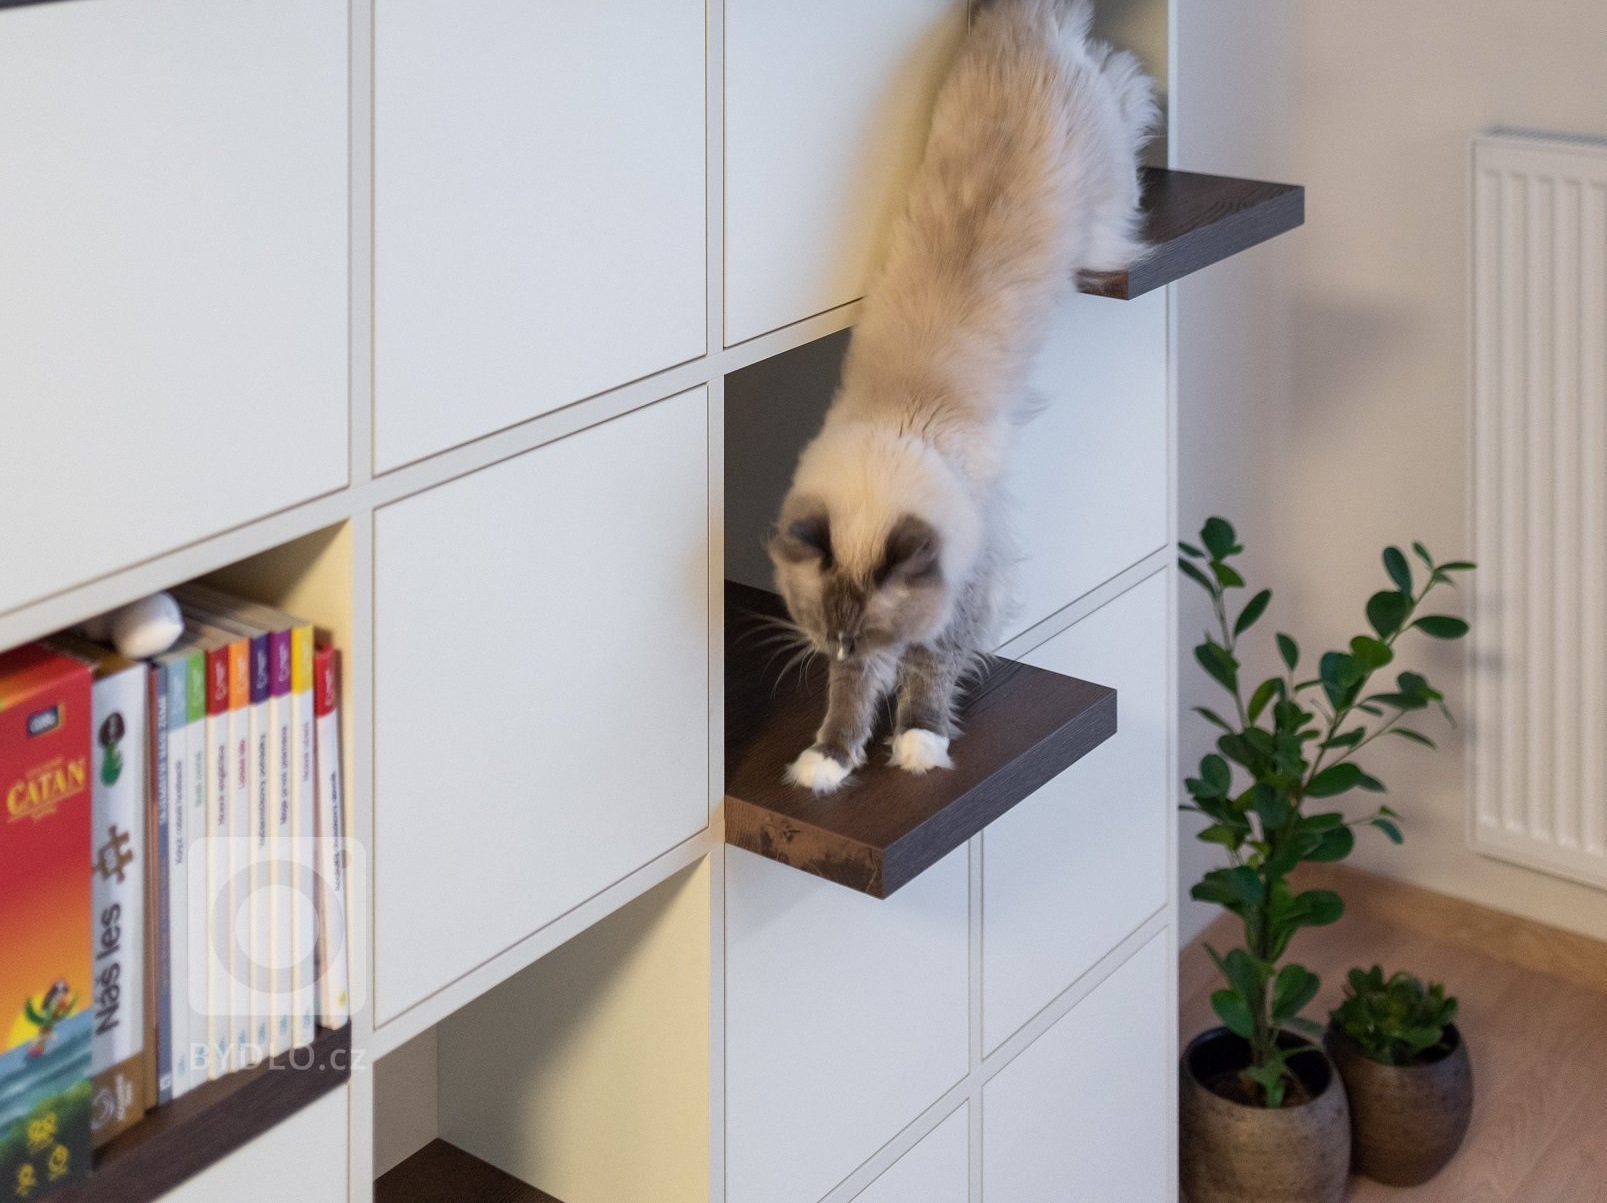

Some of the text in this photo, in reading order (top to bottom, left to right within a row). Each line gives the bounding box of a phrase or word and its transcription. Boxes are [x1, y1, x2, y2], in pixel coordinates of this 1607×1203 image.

[7, 758, 86, 816] CATAN
[94, 903, 121, 1037] Náš les
